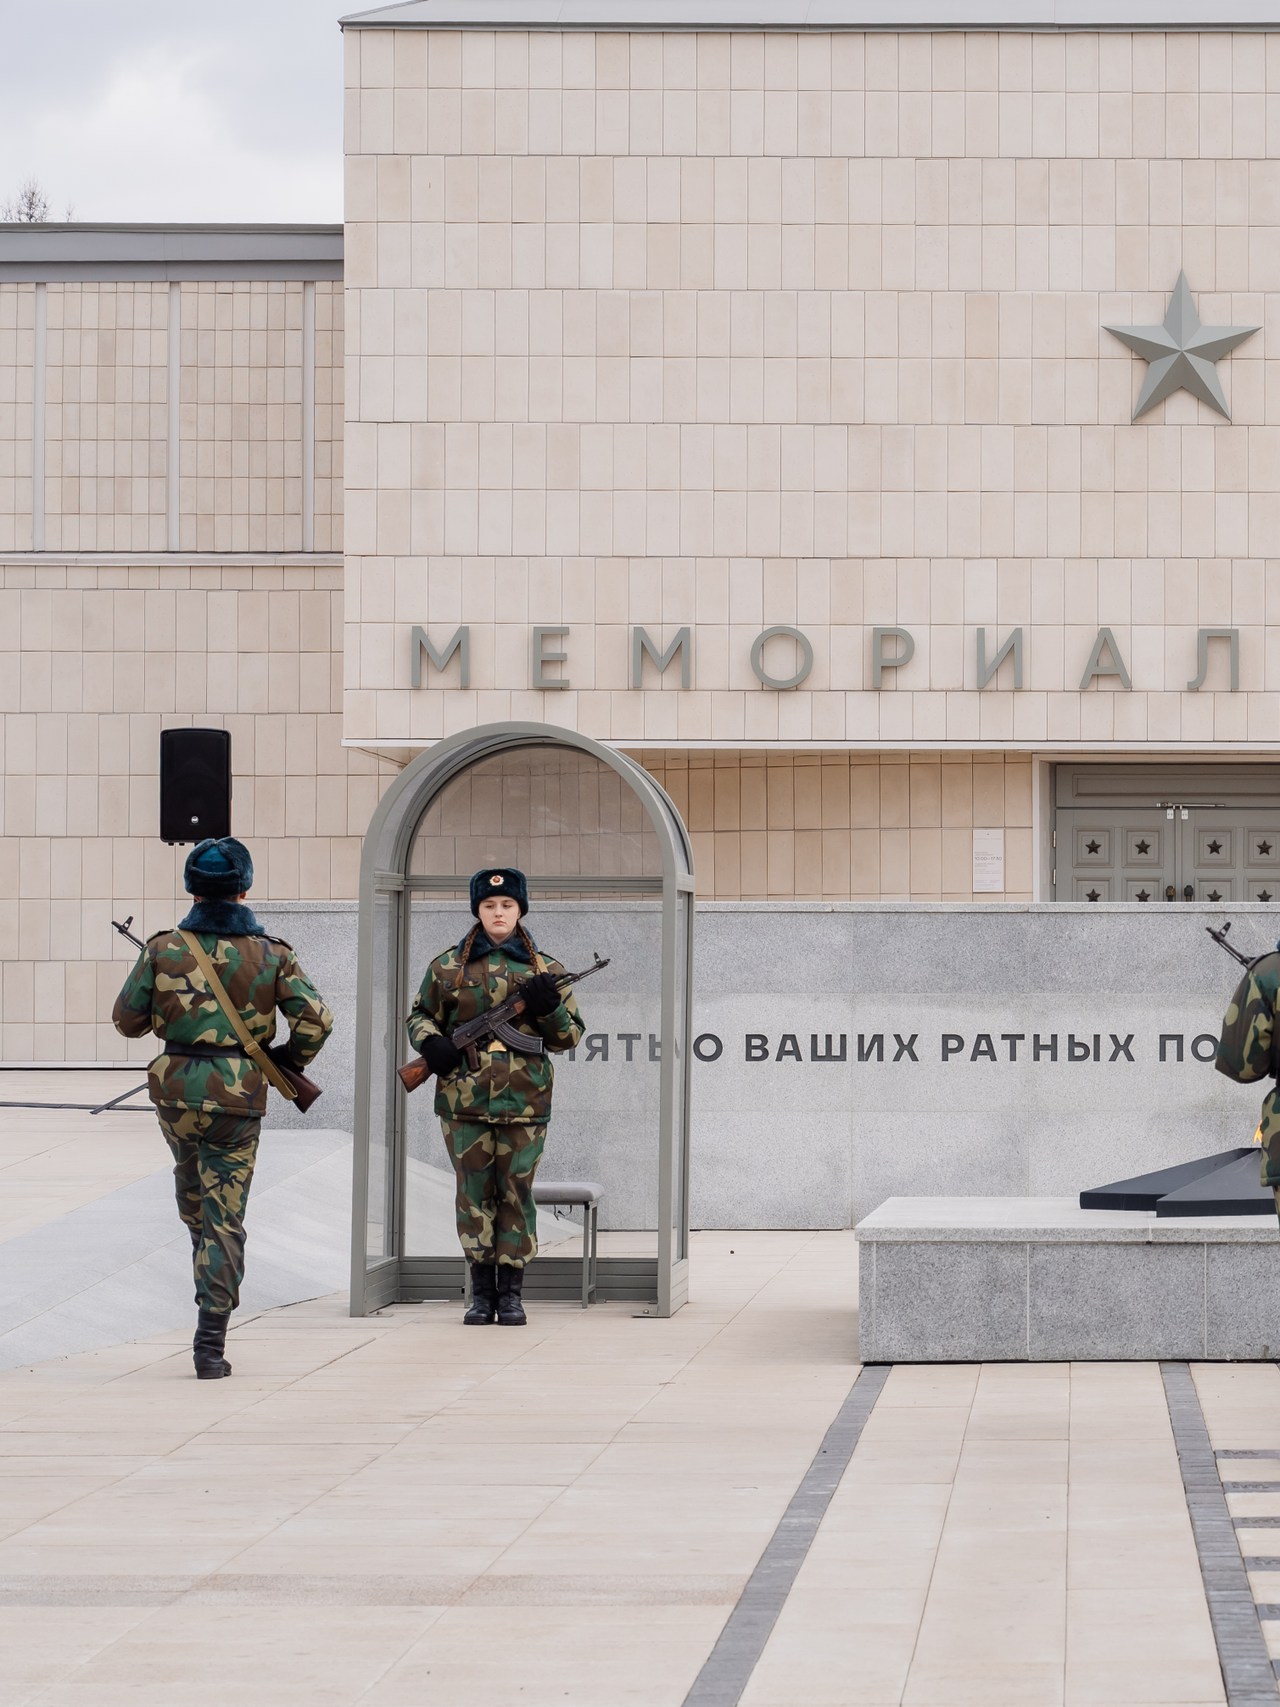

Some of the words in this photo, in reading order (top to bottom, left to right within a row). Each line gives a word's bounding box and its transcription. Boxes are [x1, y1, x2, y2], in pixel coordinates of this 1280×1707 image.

[411, 625, 1241, 692] МЕМОРИАЛ
[692, 1033, 724, 1062] О
[745, 1033, 919, 1062] ВАШИХ
[941, 1033, 1136, 1062] РАТНЫХ
